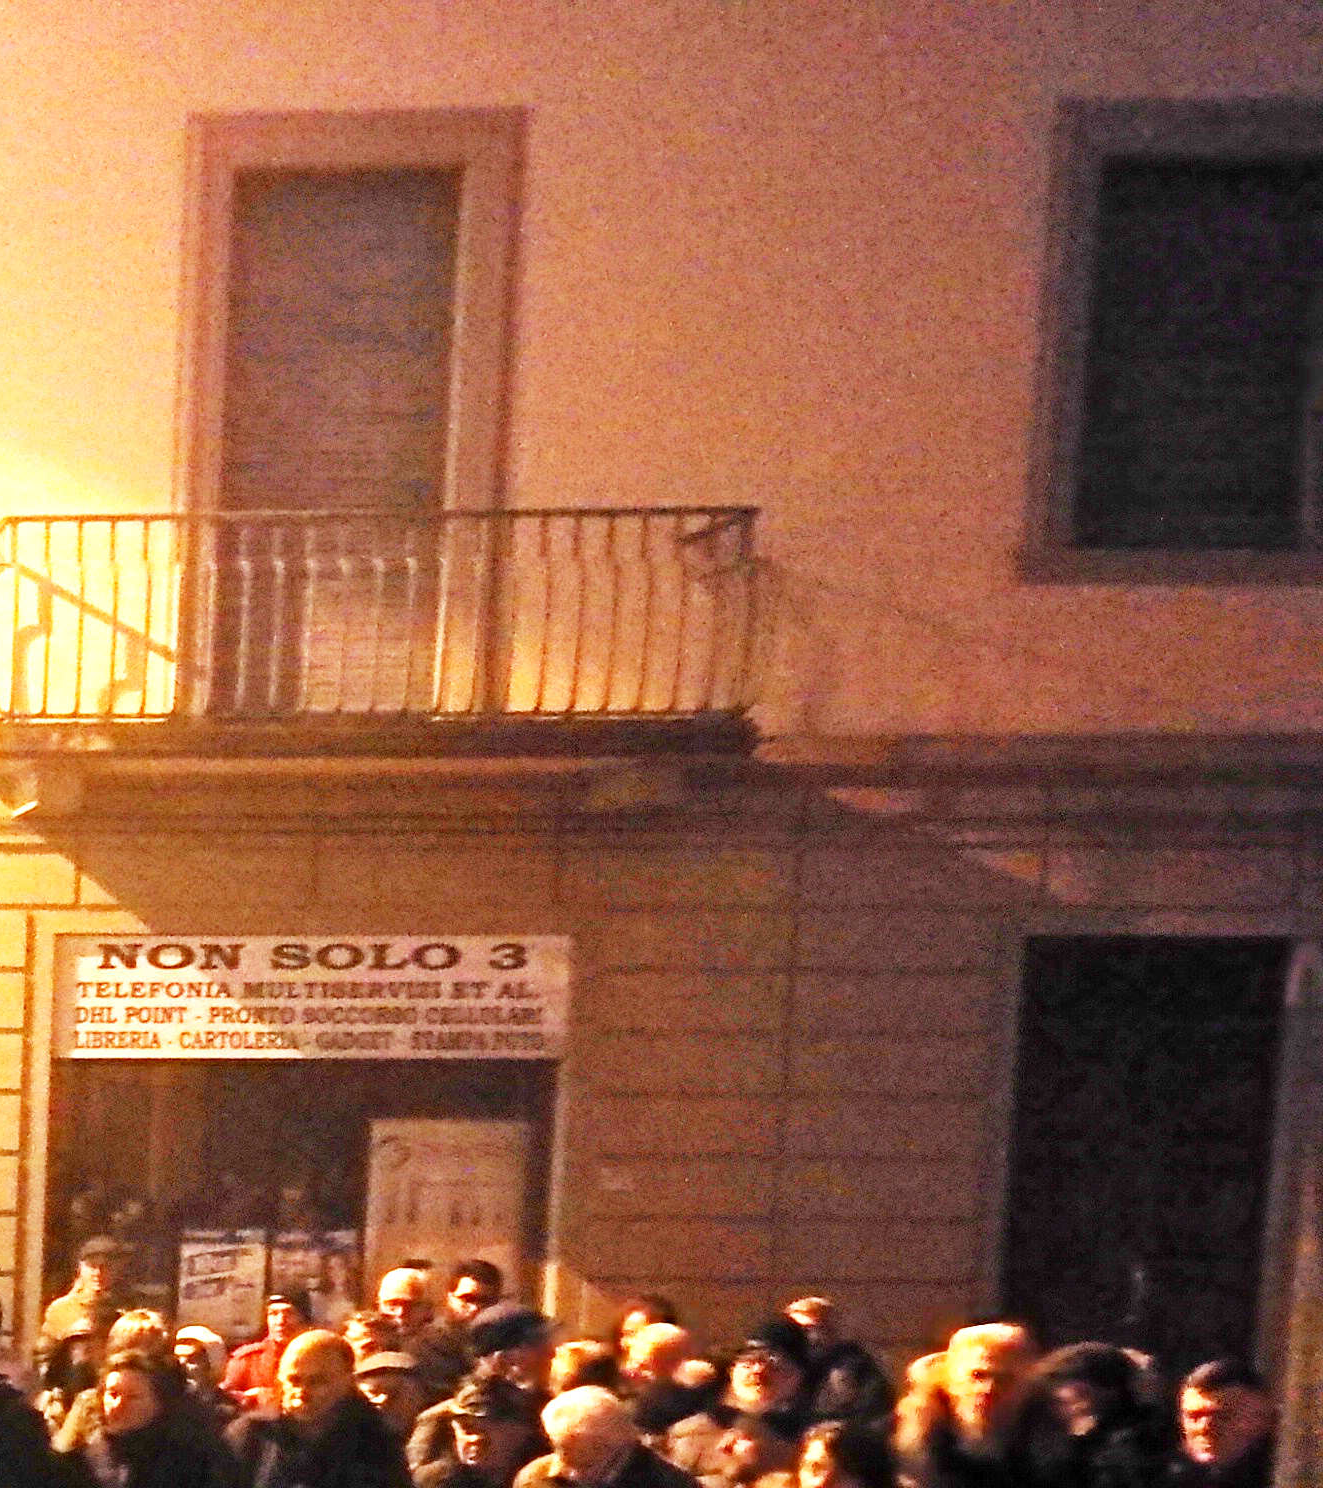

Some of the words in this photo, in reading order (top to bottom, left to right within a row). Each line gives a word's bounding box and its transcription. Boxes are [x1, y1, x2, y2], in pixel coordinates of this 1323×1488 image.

[97, 943, 245, 969] NON
[271, 943, 461, 970] SOLO
[489, 943, 527, 970] 3
[76, 982, 234, 998] TELEFONIA
[451, 981, 489, 998] ET
[75, 1007, 117, 1024] DHL
[124, 1007, 187, 1024] POINT
[209, 1007, 296, 1024] PRONTO
[74, 1031, 161, 1049] LIBRERIA
[179, 1031, 299, 1049] CARTOLERIA
